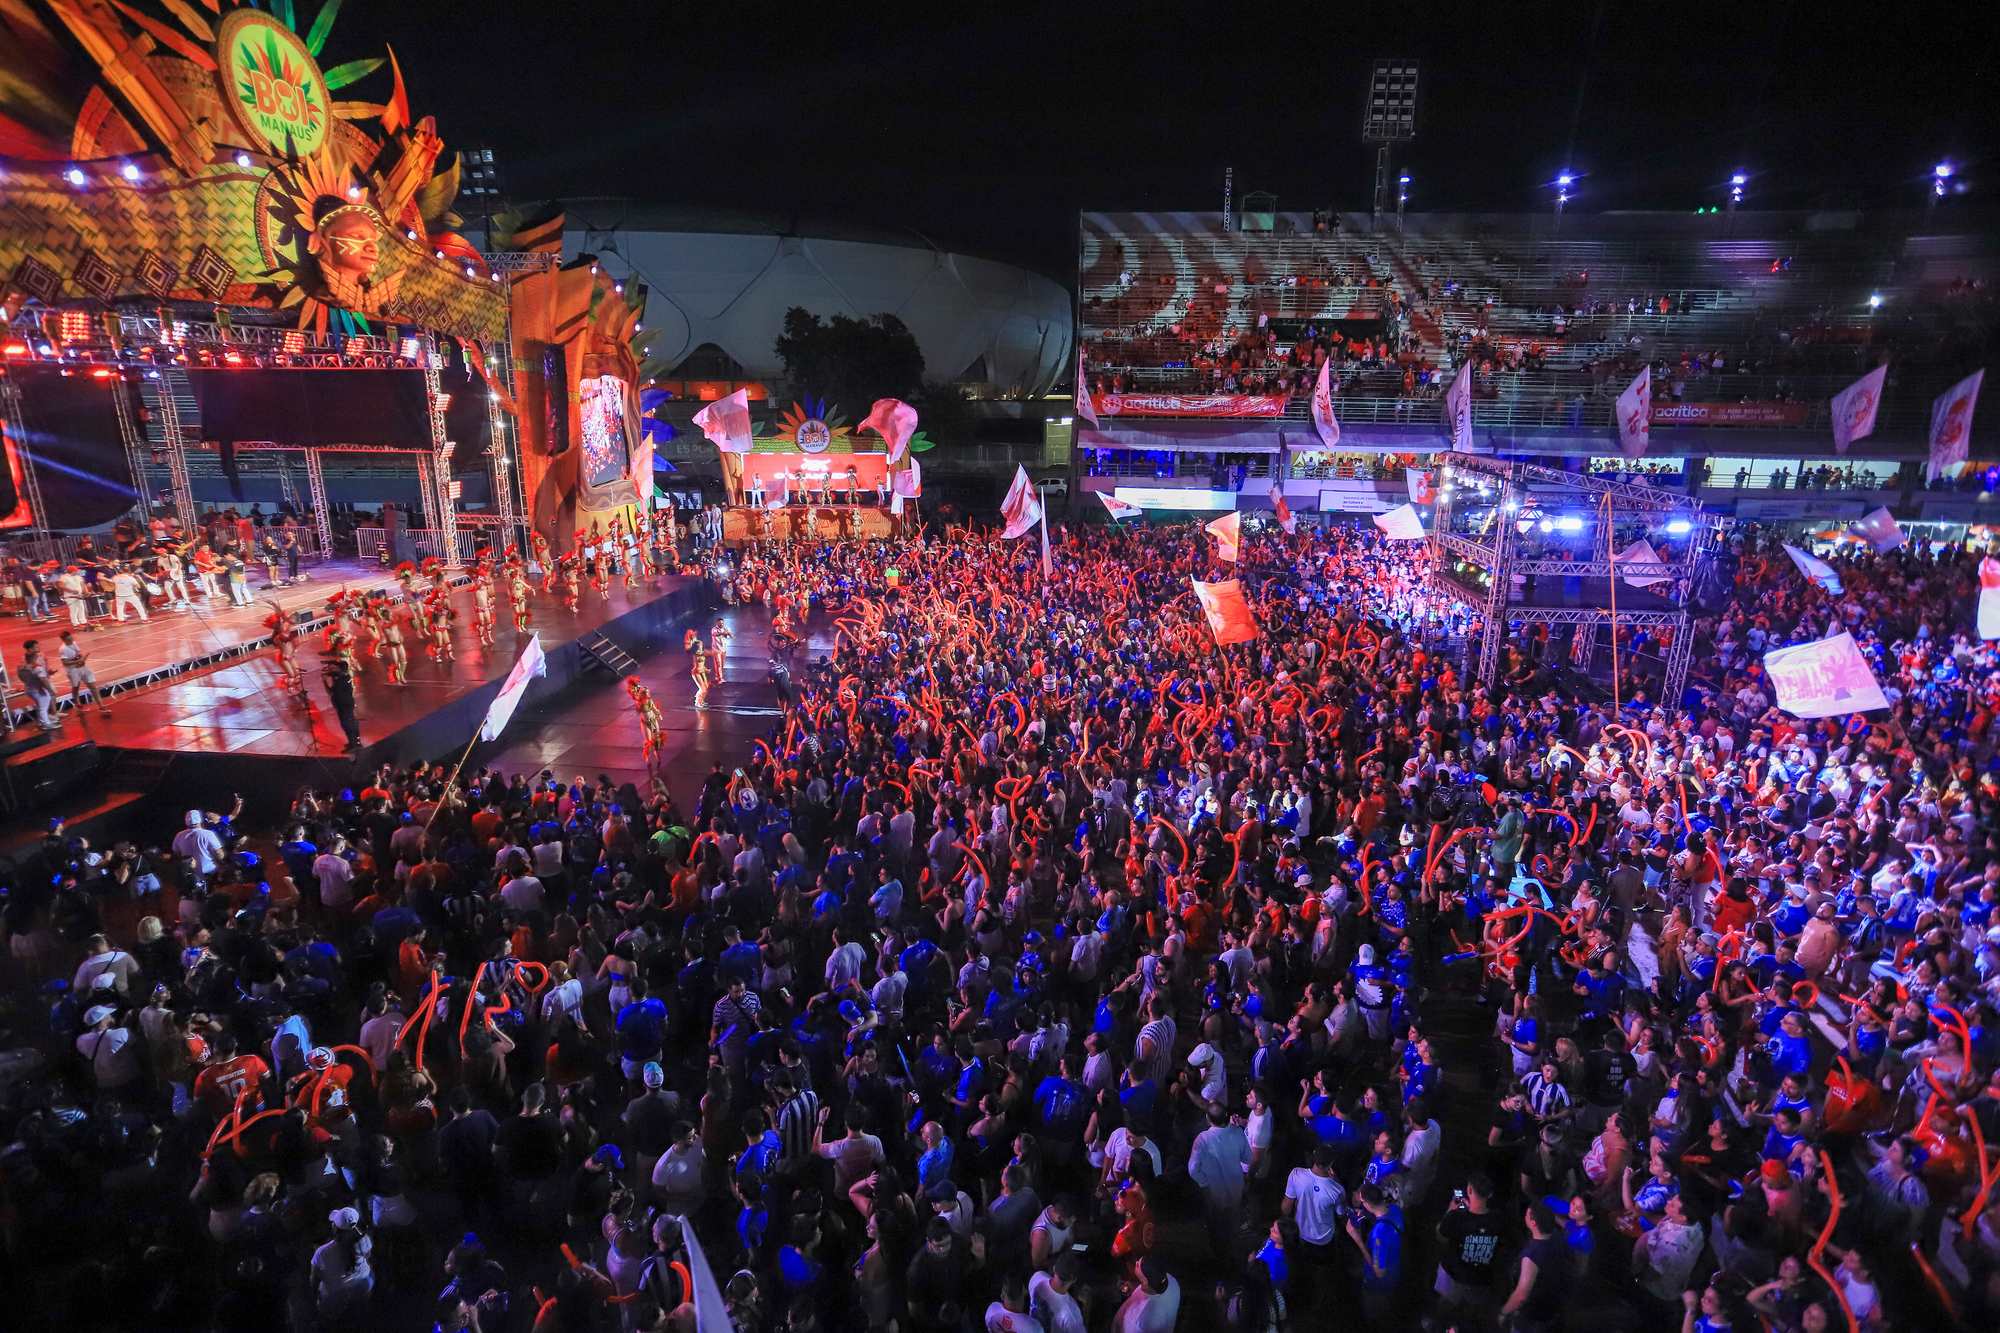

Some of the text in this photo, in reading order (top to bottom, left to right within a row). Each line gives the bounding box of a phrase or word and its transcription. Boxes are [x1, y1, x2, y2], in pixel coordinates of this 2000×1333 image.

[250, 70, 310, 126] BOI
[260, 114, 313, 141] MANAUS
[803, 431, 823, 444] BOI
